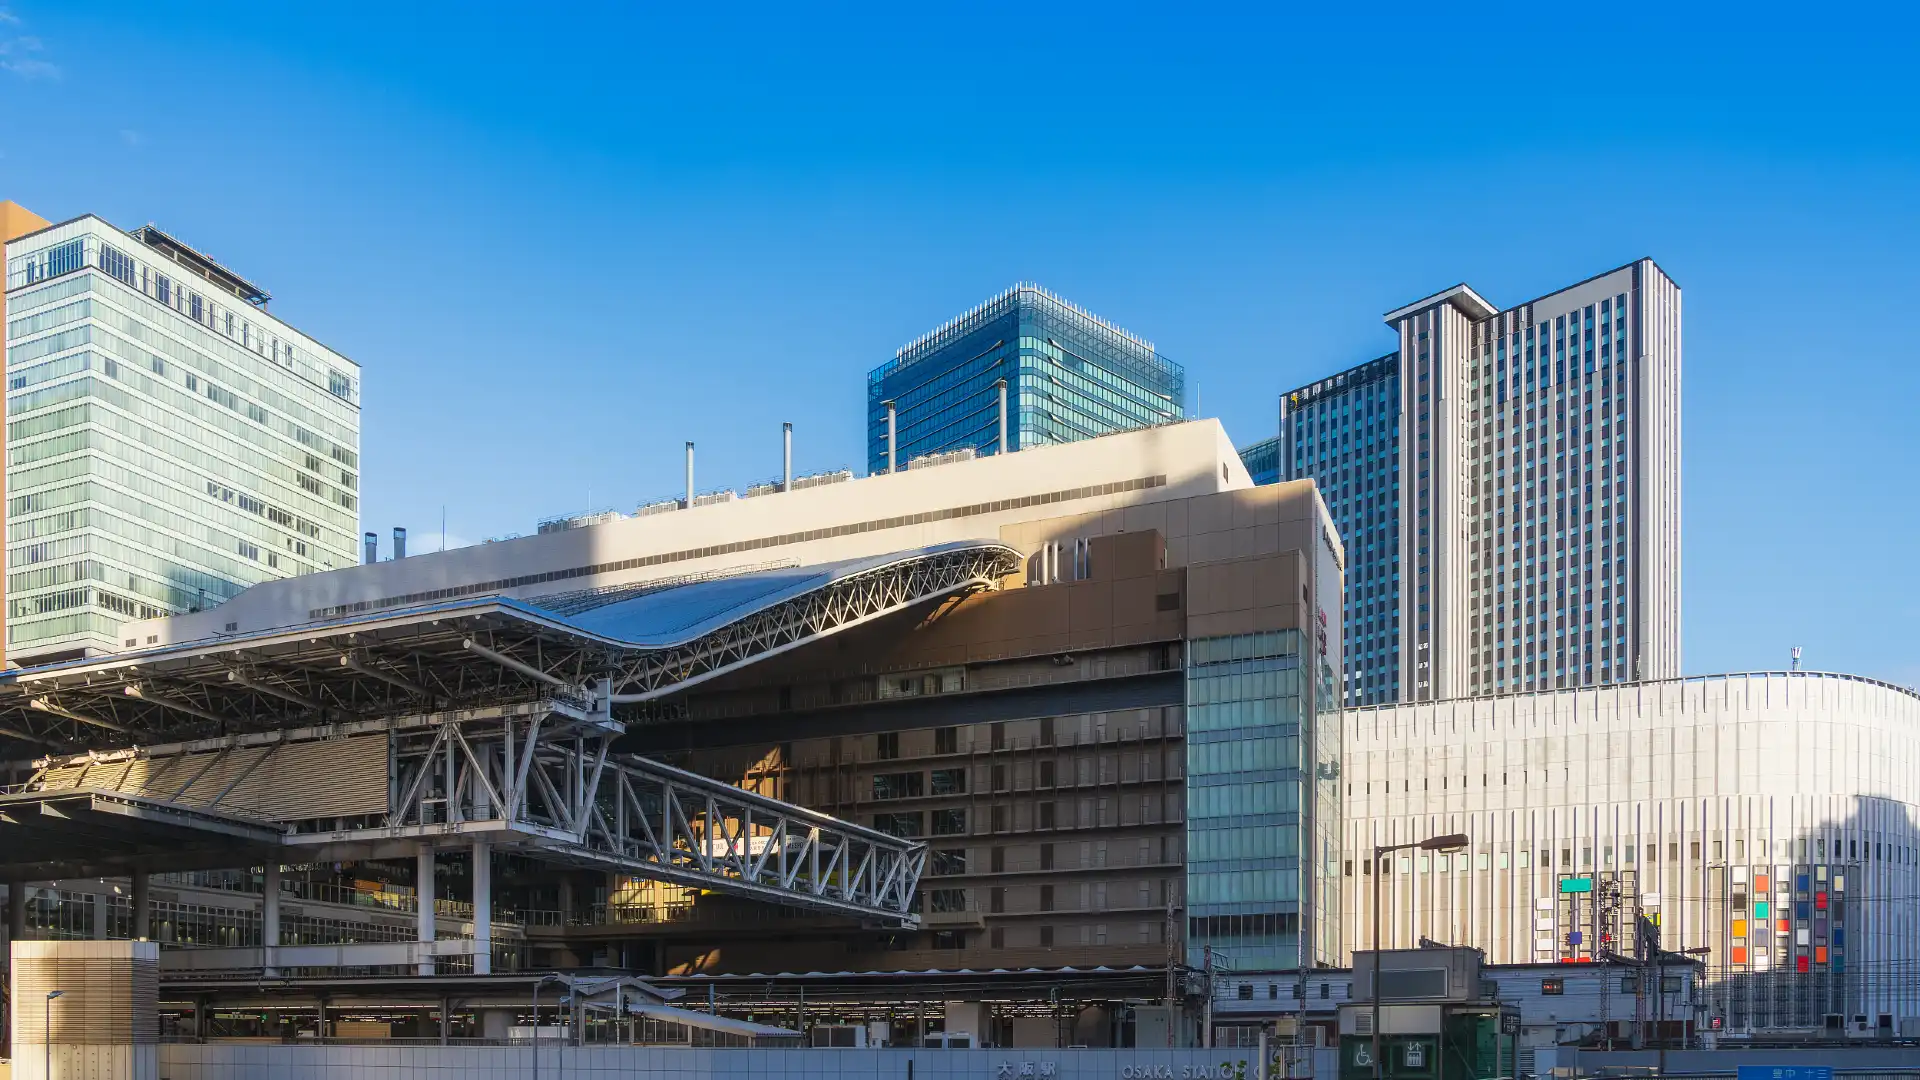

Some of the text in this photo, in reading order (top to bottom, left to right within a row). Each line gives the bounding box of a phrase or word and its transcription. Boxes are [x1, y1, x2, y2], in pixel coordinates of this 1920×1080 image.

[997, 1061, 1056, 1076] 大阪駅
[1121, 1064, 1173, 1079] OSAKA
[1804, 1068, 1828, 1079] 十三
